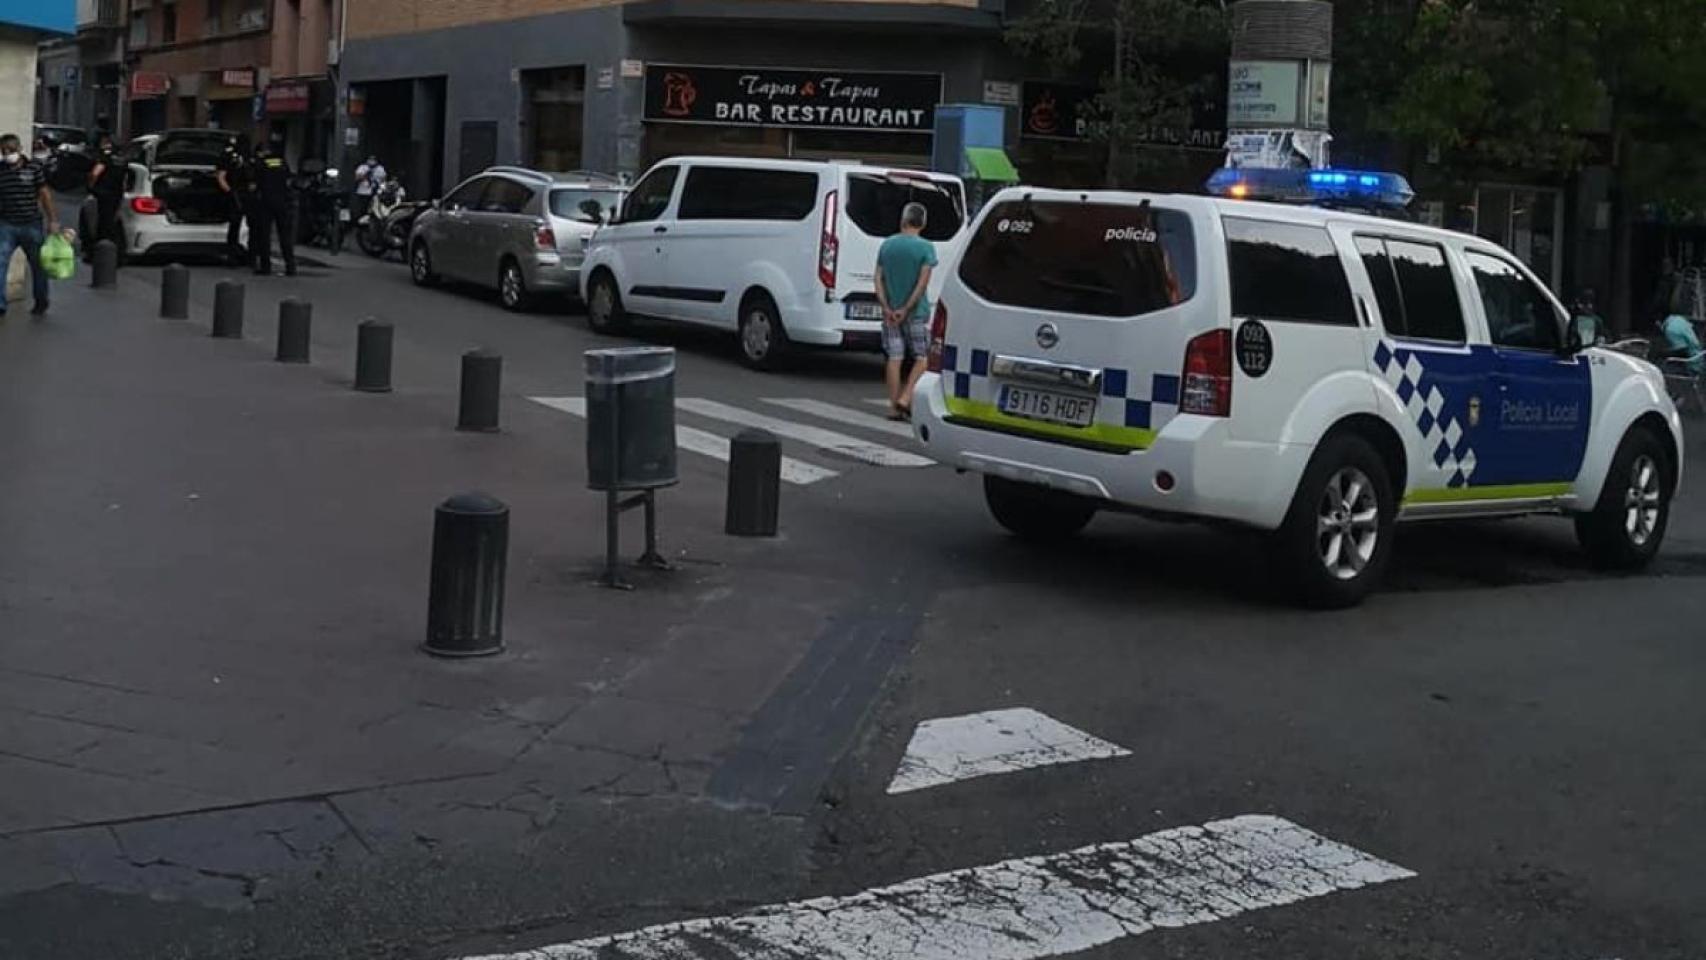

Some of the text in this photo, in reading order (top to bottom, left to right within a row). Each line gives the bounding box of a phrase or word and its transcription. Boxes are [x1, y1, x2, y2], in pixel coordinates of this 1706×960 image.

[739, 75, 880, 103] Tapas & Tapas
[715, 102, 924, 126] BAR RESTAURANT
[1010, 219, 1034, 233] 092
[1243, 324, 1264, 342] 092
[1244, 353, 1265, 371] 112
[1010, 389, 1090, 421] 9116 HDF
[1546, 399, 1579, 421] Local
